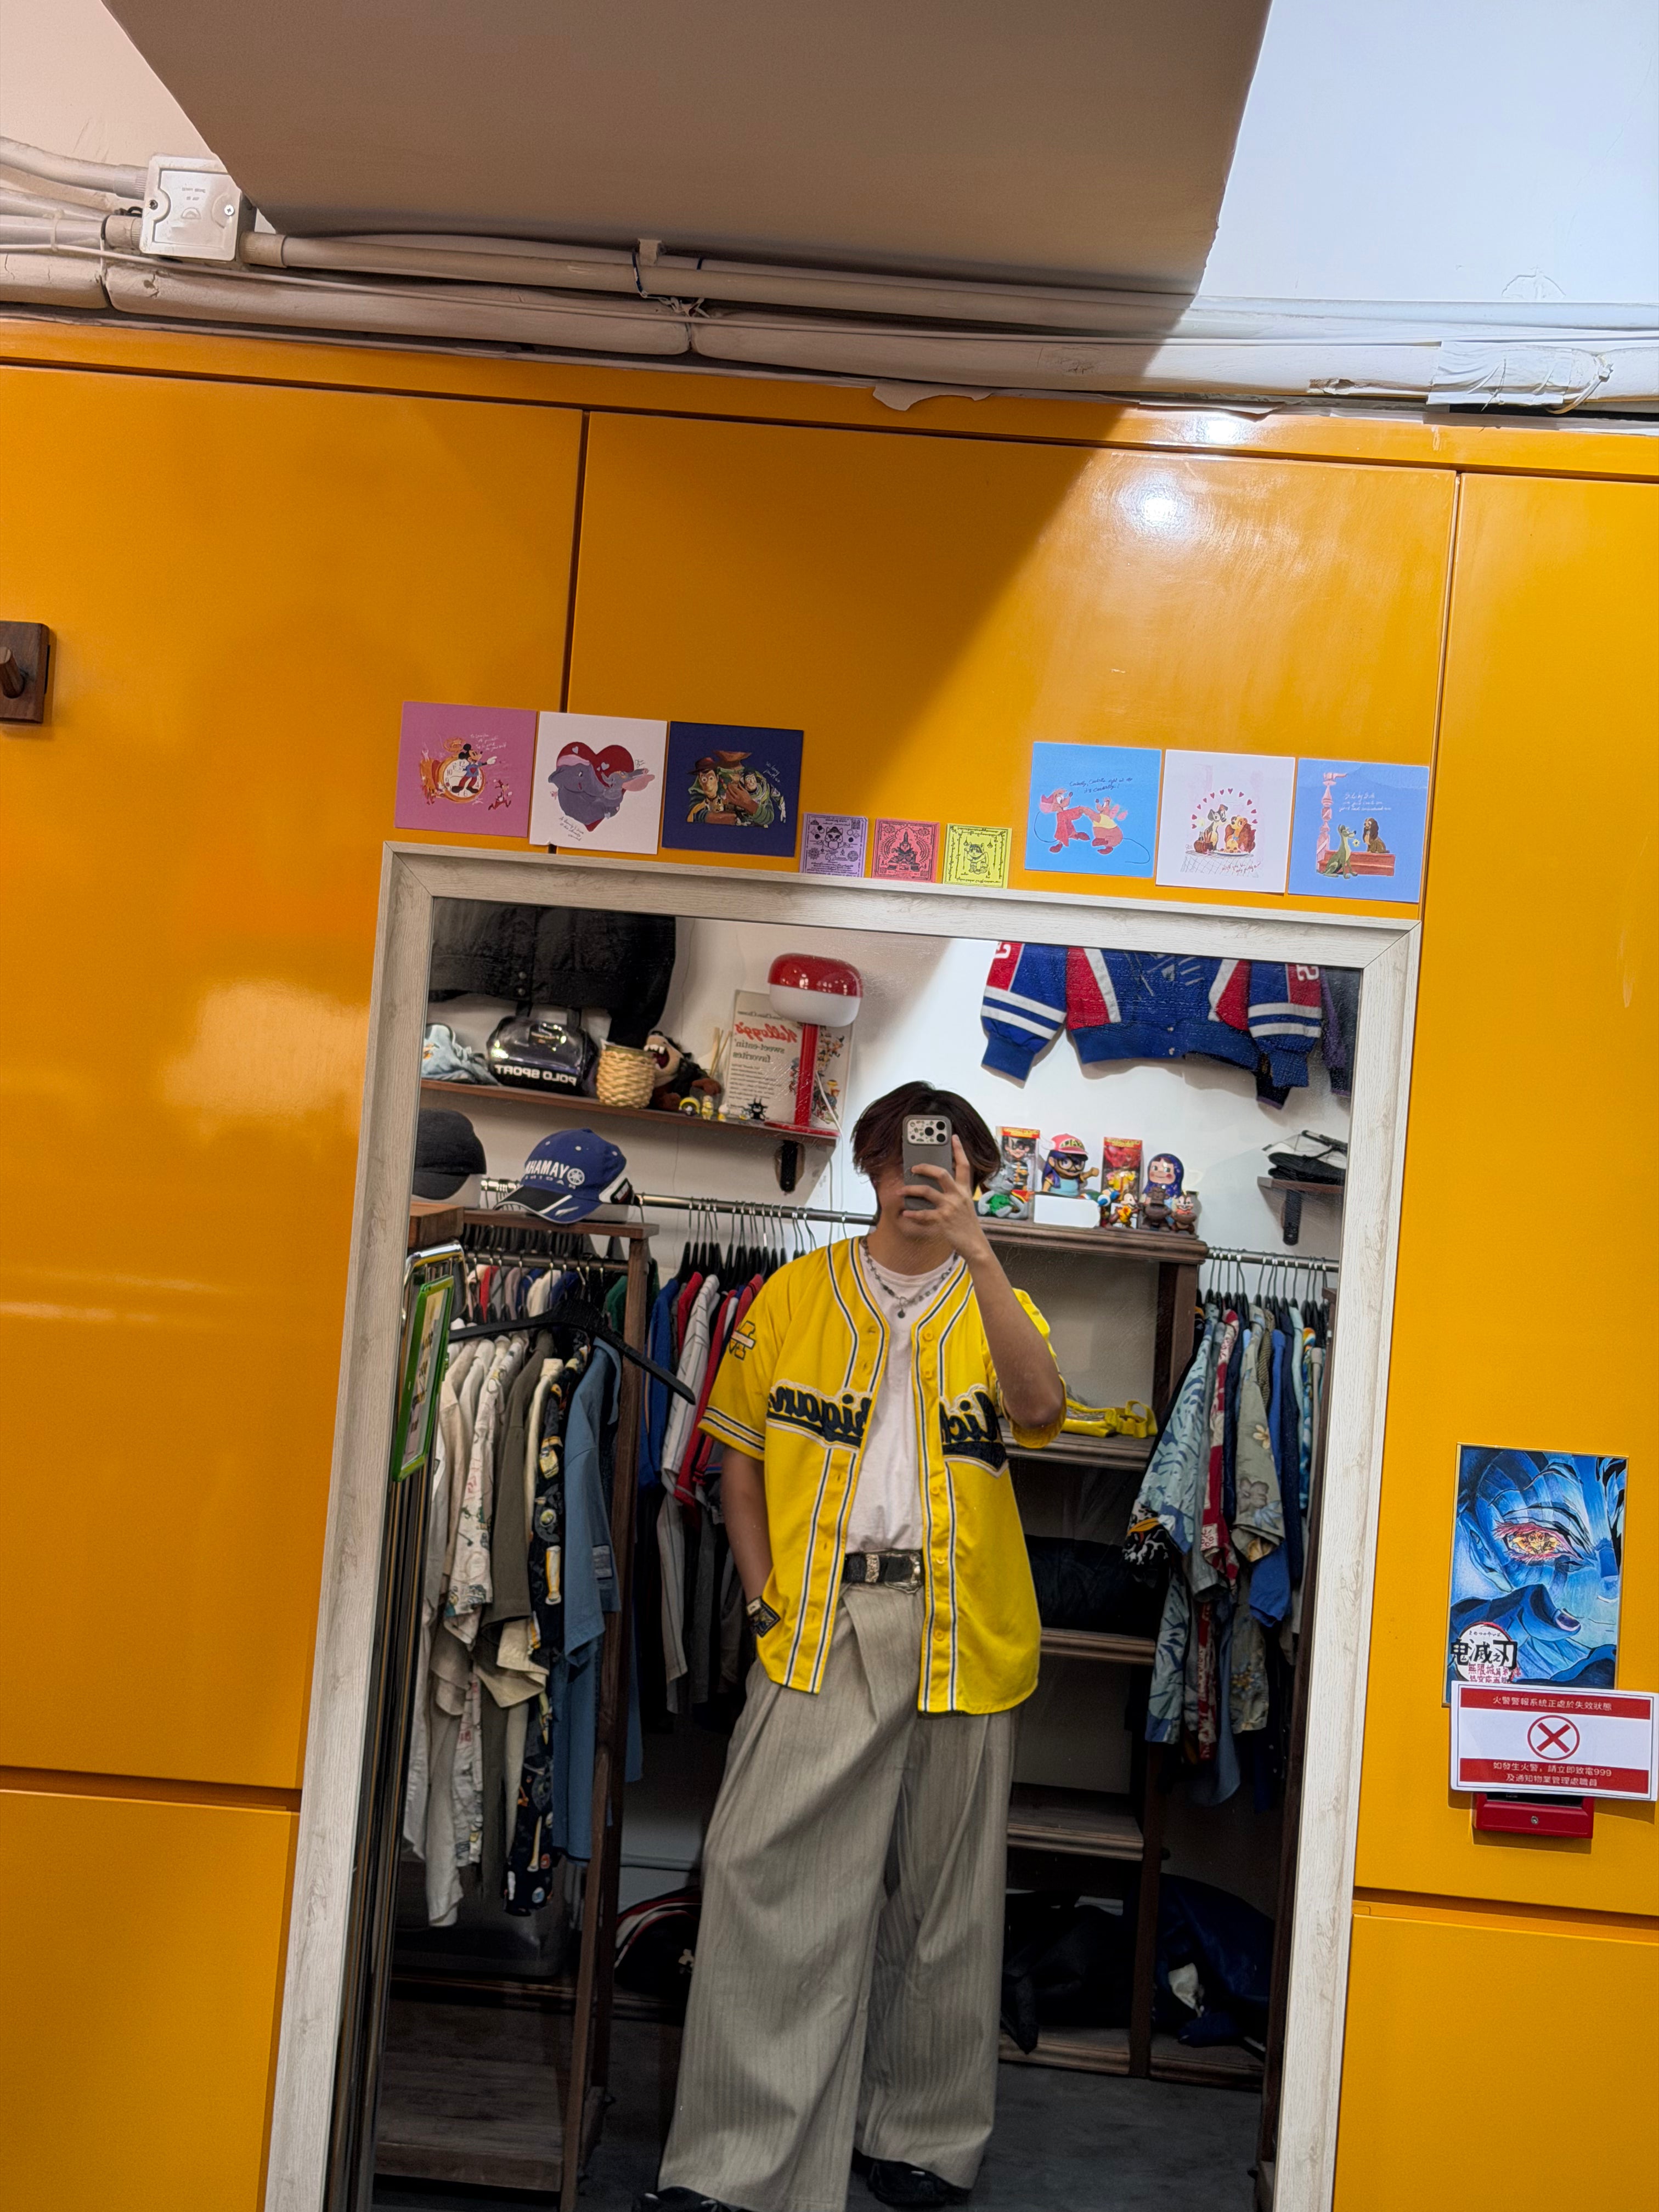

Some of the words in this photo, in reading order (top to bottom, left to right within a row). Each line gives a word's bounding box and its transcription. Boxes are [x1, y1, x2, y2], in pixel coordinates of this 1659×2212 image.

[1449, 1638, 1519, 1671] 鬼滅之刃
[1493, 1696, 1612, 1711] 火警警報系統正處於失效狀態
[1505, 1773, 1598, 1787] 及通知物業管理處職員
